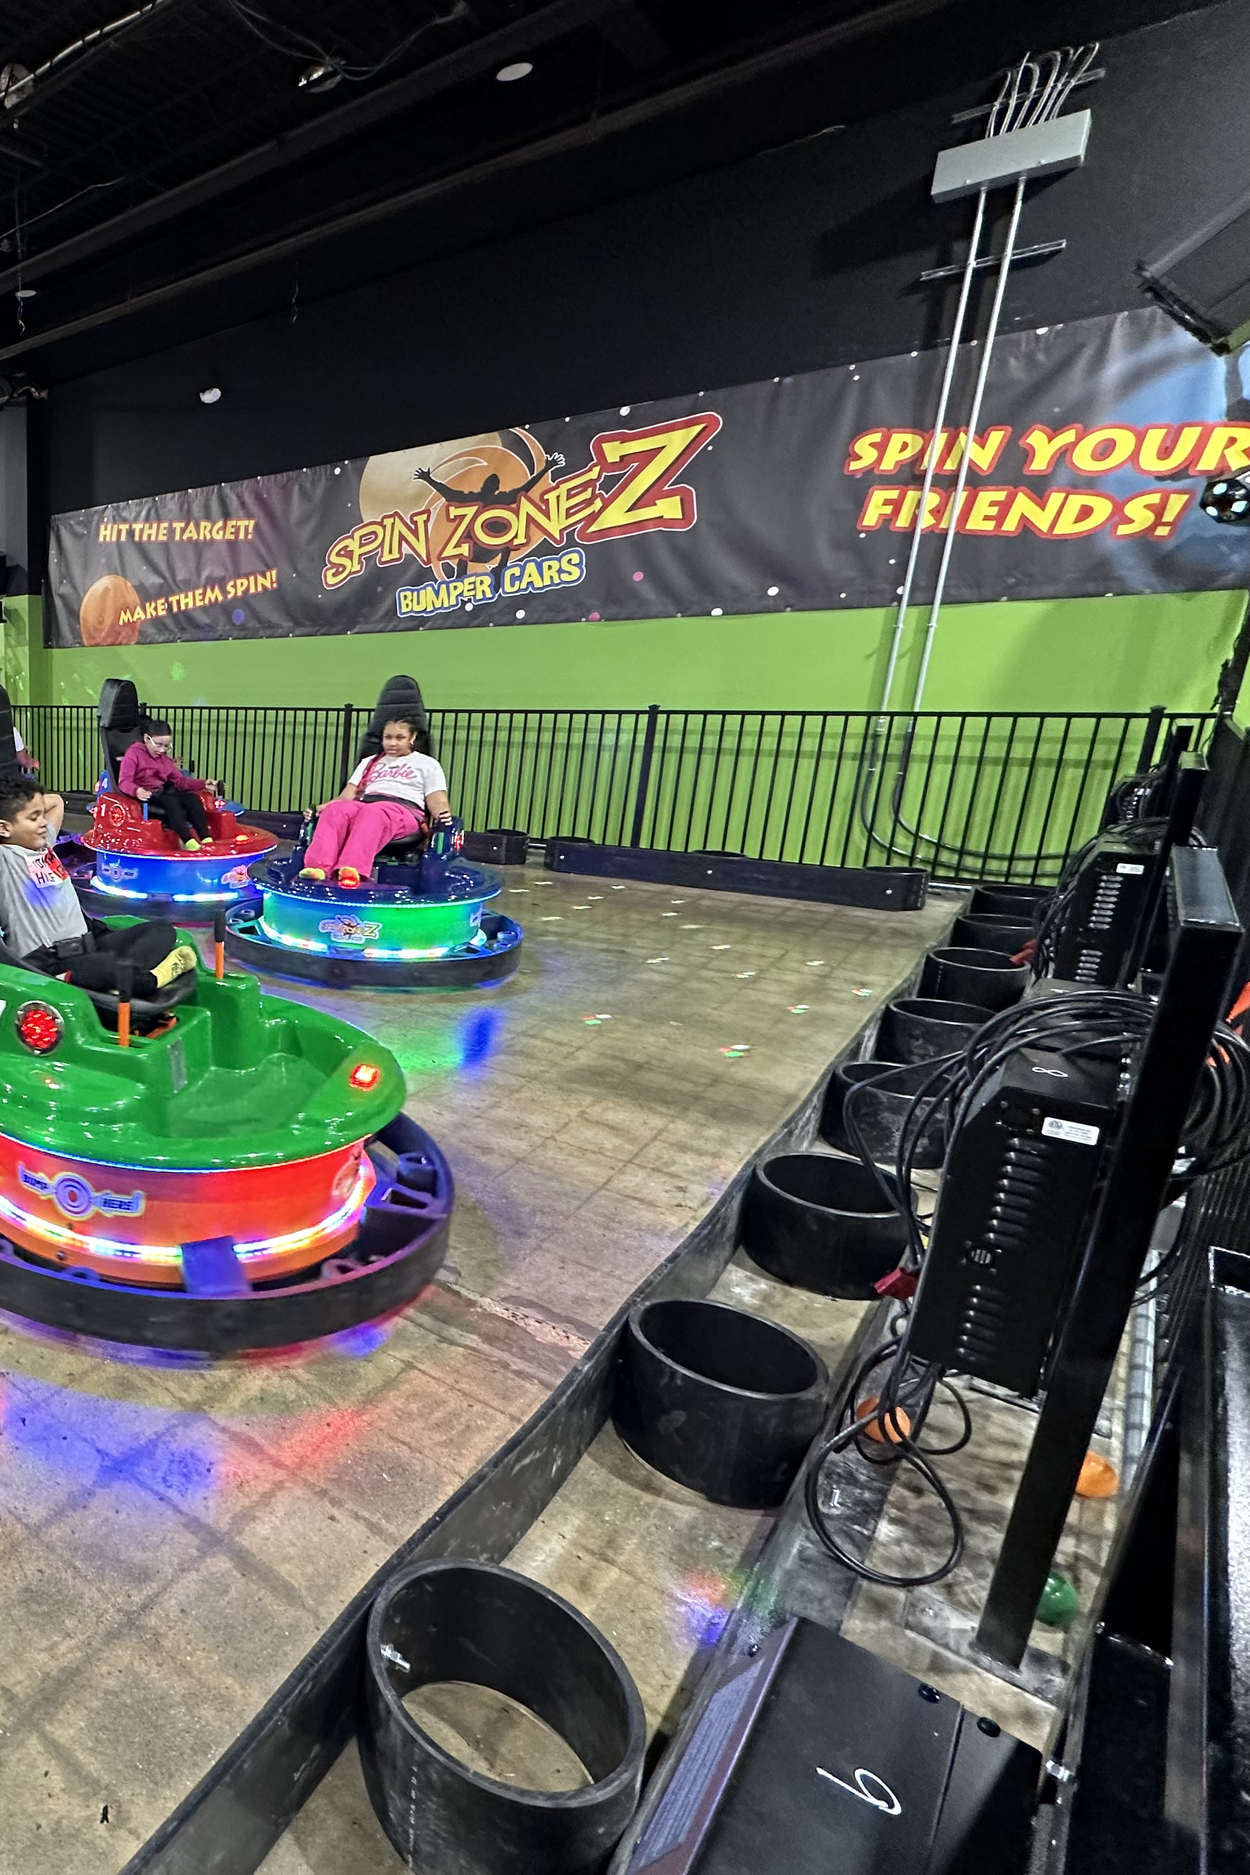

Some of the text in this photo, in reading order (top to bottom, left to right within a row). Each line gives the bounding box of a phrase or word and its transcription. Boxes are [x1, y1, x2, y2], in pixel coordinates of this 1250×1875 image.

[846, 425, 1250, 474] SPIN YOUR
[98, 518, 256, 542] HIT THE TARGET!
[860, 488, 1191, 537] FRIENDS!
[324, 511, 431, 587] SPIN
[118, 569, 278, 626] MAKE THEM SPIN!
[398, 550, 585, 616] BUMPER CARS
[101, 777, 108, 789] 4
[369, 762, 418, 782] Barbie
[100, 803, 106, 817] 1
